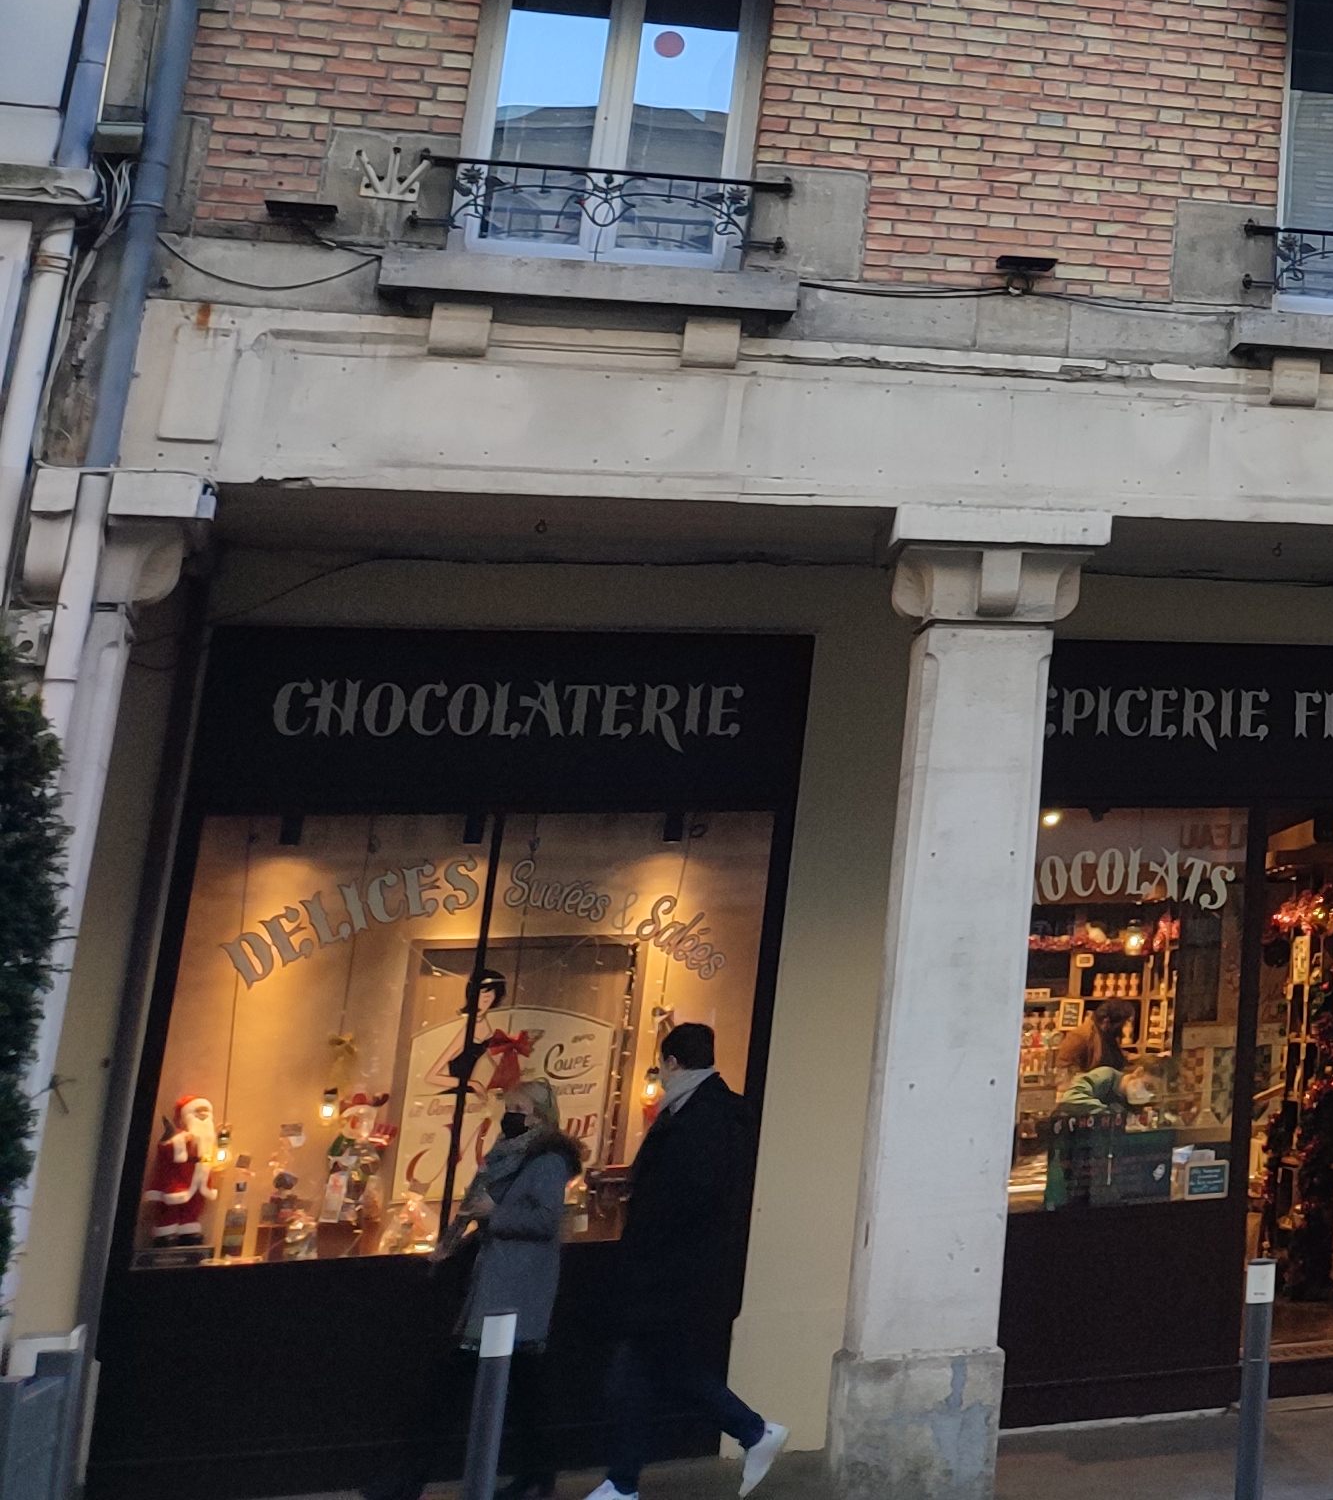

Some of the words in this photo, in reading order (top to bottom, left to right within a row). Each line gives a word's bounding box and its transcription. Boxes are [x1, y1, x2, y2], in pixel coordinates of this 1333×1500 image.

[272, 677, 745, 753] CHOCOLATERIE
[1034, 846, 1236, 911] OCOLATS
[219, 854, 481, 991] DELICES
[504, 859, 612, 923] Sucrées
[636, 895, 726, 981] Salées
